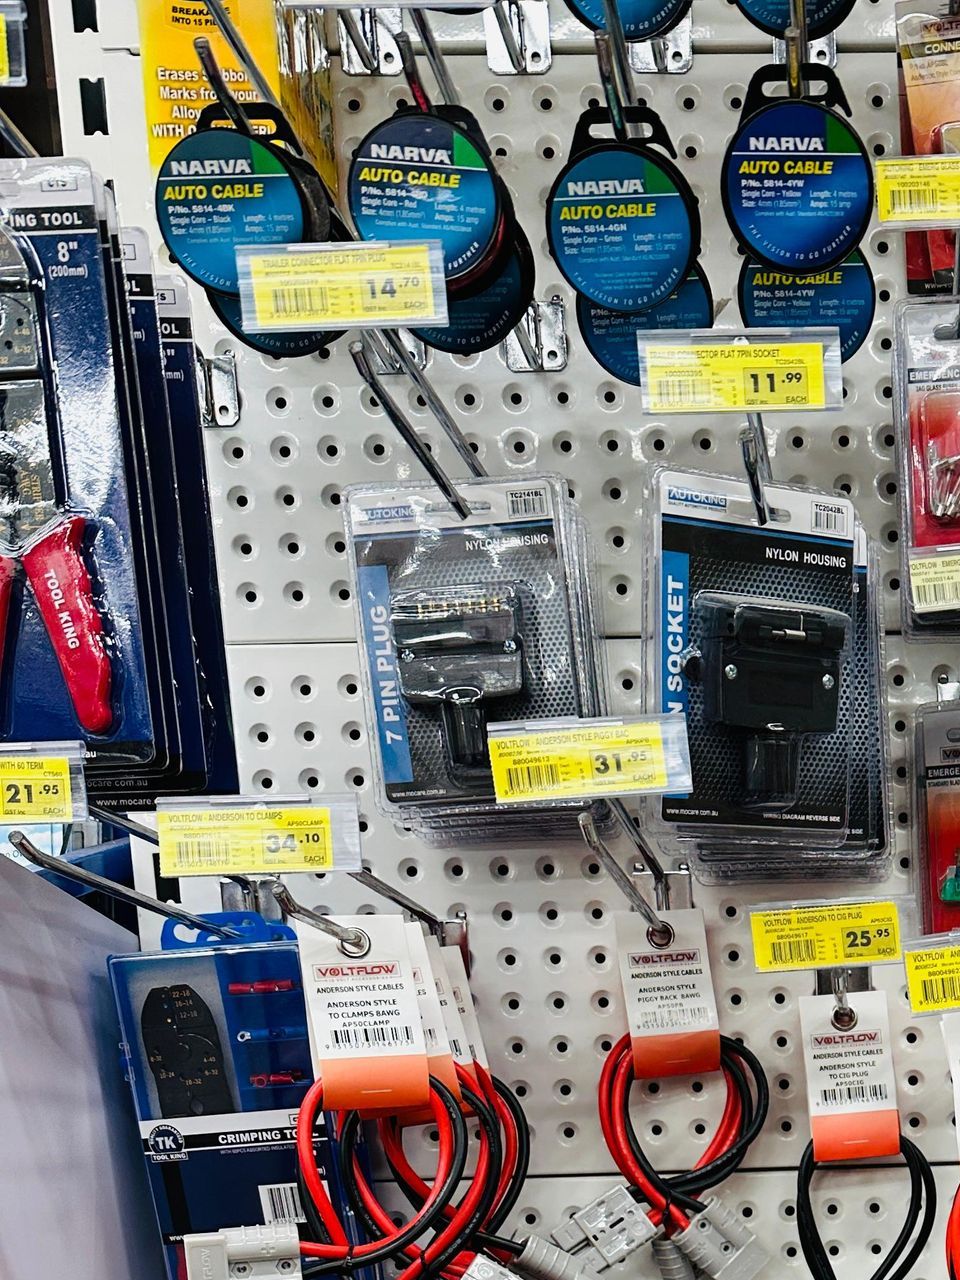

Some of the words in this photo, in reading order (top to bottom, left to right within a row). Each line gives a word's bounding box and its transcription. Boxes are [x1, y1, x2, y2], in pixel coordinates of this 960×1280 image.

[749, 138, 823, 151] NARVA
[371, 145, 451, 163] NARVA
[171, 160, 251, 175] NARVA
[739, 162, 780, 175] AUTO
[784, 162, 833, 175] CABLE
[359, 168, 402, 183] AUTO
[407, 171, 460, 187] CABLE
[164, 186, 207, 200] AUTO
[212, 184, 264, 197] CABLE
[41, 213, 82, 225] TOOL
[57, 241, 78, 262] 8"
[49, 265, 88, 278] (200mm)
[815, 504, 844, 514] TC2042BL
[765, 548, 798, 561] NYLON
[804, 551, 846, 568] HOUSING
[44, 570, 68, 612] TOOL
[59, 611, 80, 650] KING
[370, 606, 390, 667] PLUG
[667, 575, 686, 692] SOCKET
[381, 675, 397, 721] PIN
[386, 728, 402, 743] 7
[912, 952, 945, 962] VOLTFLOW
[317, 964, 395, 977] VOLTFLOW
[355, 984, 376, 992] STYLE
[378, 983, 404, 991] CABLES
